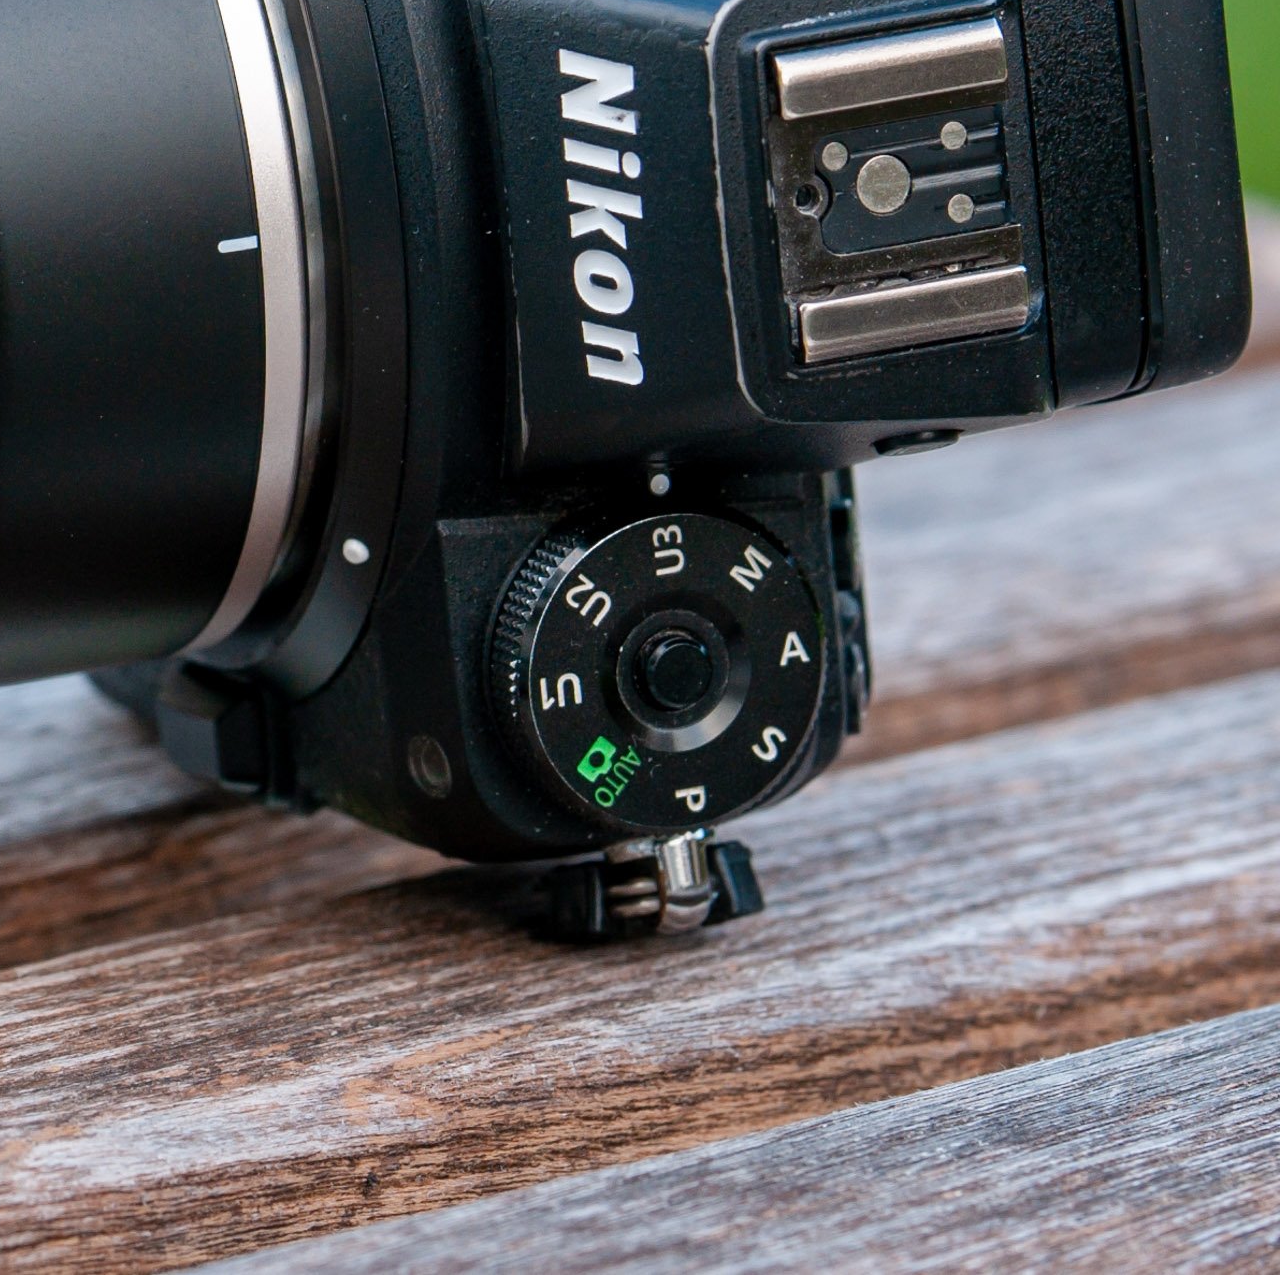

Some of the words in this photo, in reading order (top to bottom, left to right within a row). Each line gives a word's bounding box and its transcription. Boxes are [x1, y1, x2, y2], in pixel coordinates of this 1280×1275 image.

[558, 48, 644, 386] Nikon
[652, 524, 686, 577] U3
[729, 544, 773, 592] M
[565, 573, 612, 627] U2
[779, 631, 810, 667] A
[540, 672, 584, 711] U1
[751, 726, 787, 763] S
[594, 745, 642, 808] AUTO
[675, 785, 706, 813] P
